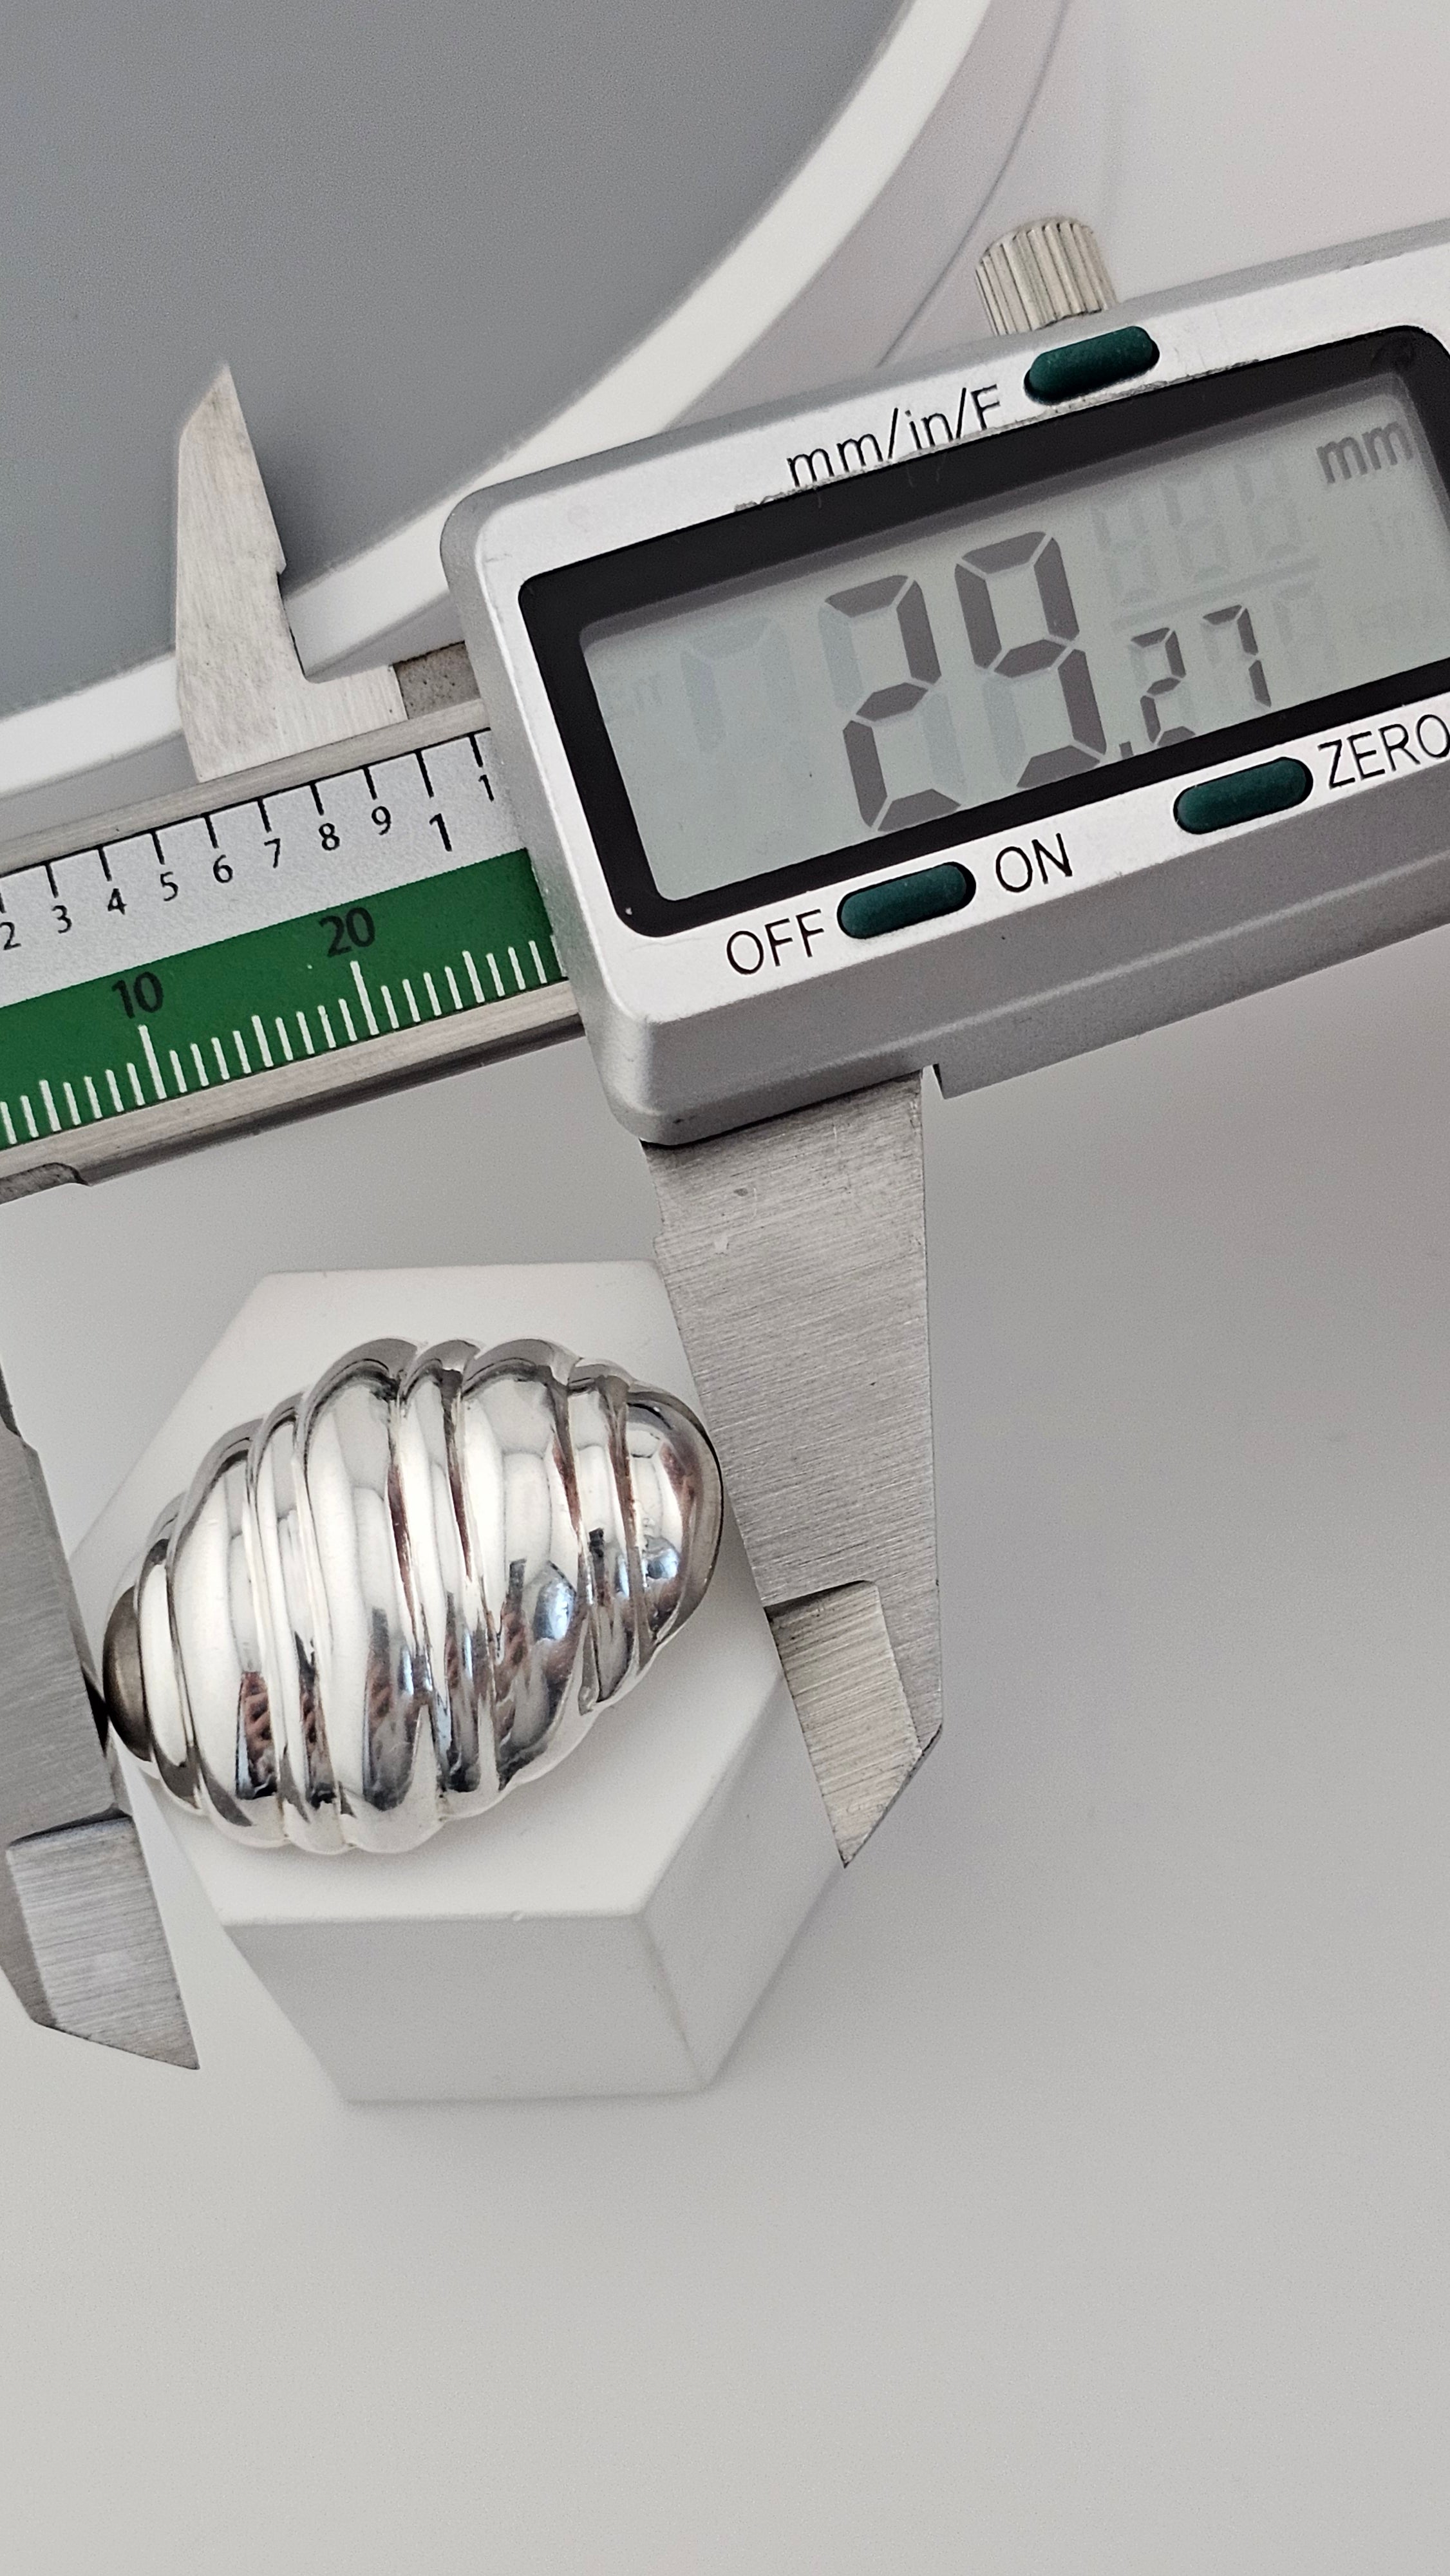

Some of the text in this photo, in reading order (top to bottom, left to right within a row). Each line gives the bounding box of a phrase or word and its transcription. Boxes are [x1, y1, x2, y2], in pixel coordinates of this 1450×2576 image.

[786, 384, 1001, 488] mm/in/F
[1315, 421, 1413, 484] mm
[1318, 714, 1450, 790] ZERO
[0, 922, 21, 951] 2
[52, 905, 73, 933] 3
[106, 888, 127, 914] 4
[160, 872, 179, 901] 5
[212, 855, 234, 883] 6
[263, 838, 282, 868] 7
[318, 823, 340, 851] 8
[371, 806, 391, 835] 9
[429, 813, 452, 851] 1
[995, 833, 1072, 893] ON
[111, 907, 376, 1019] 10 20
[726, 909, 824, 975] OFF
